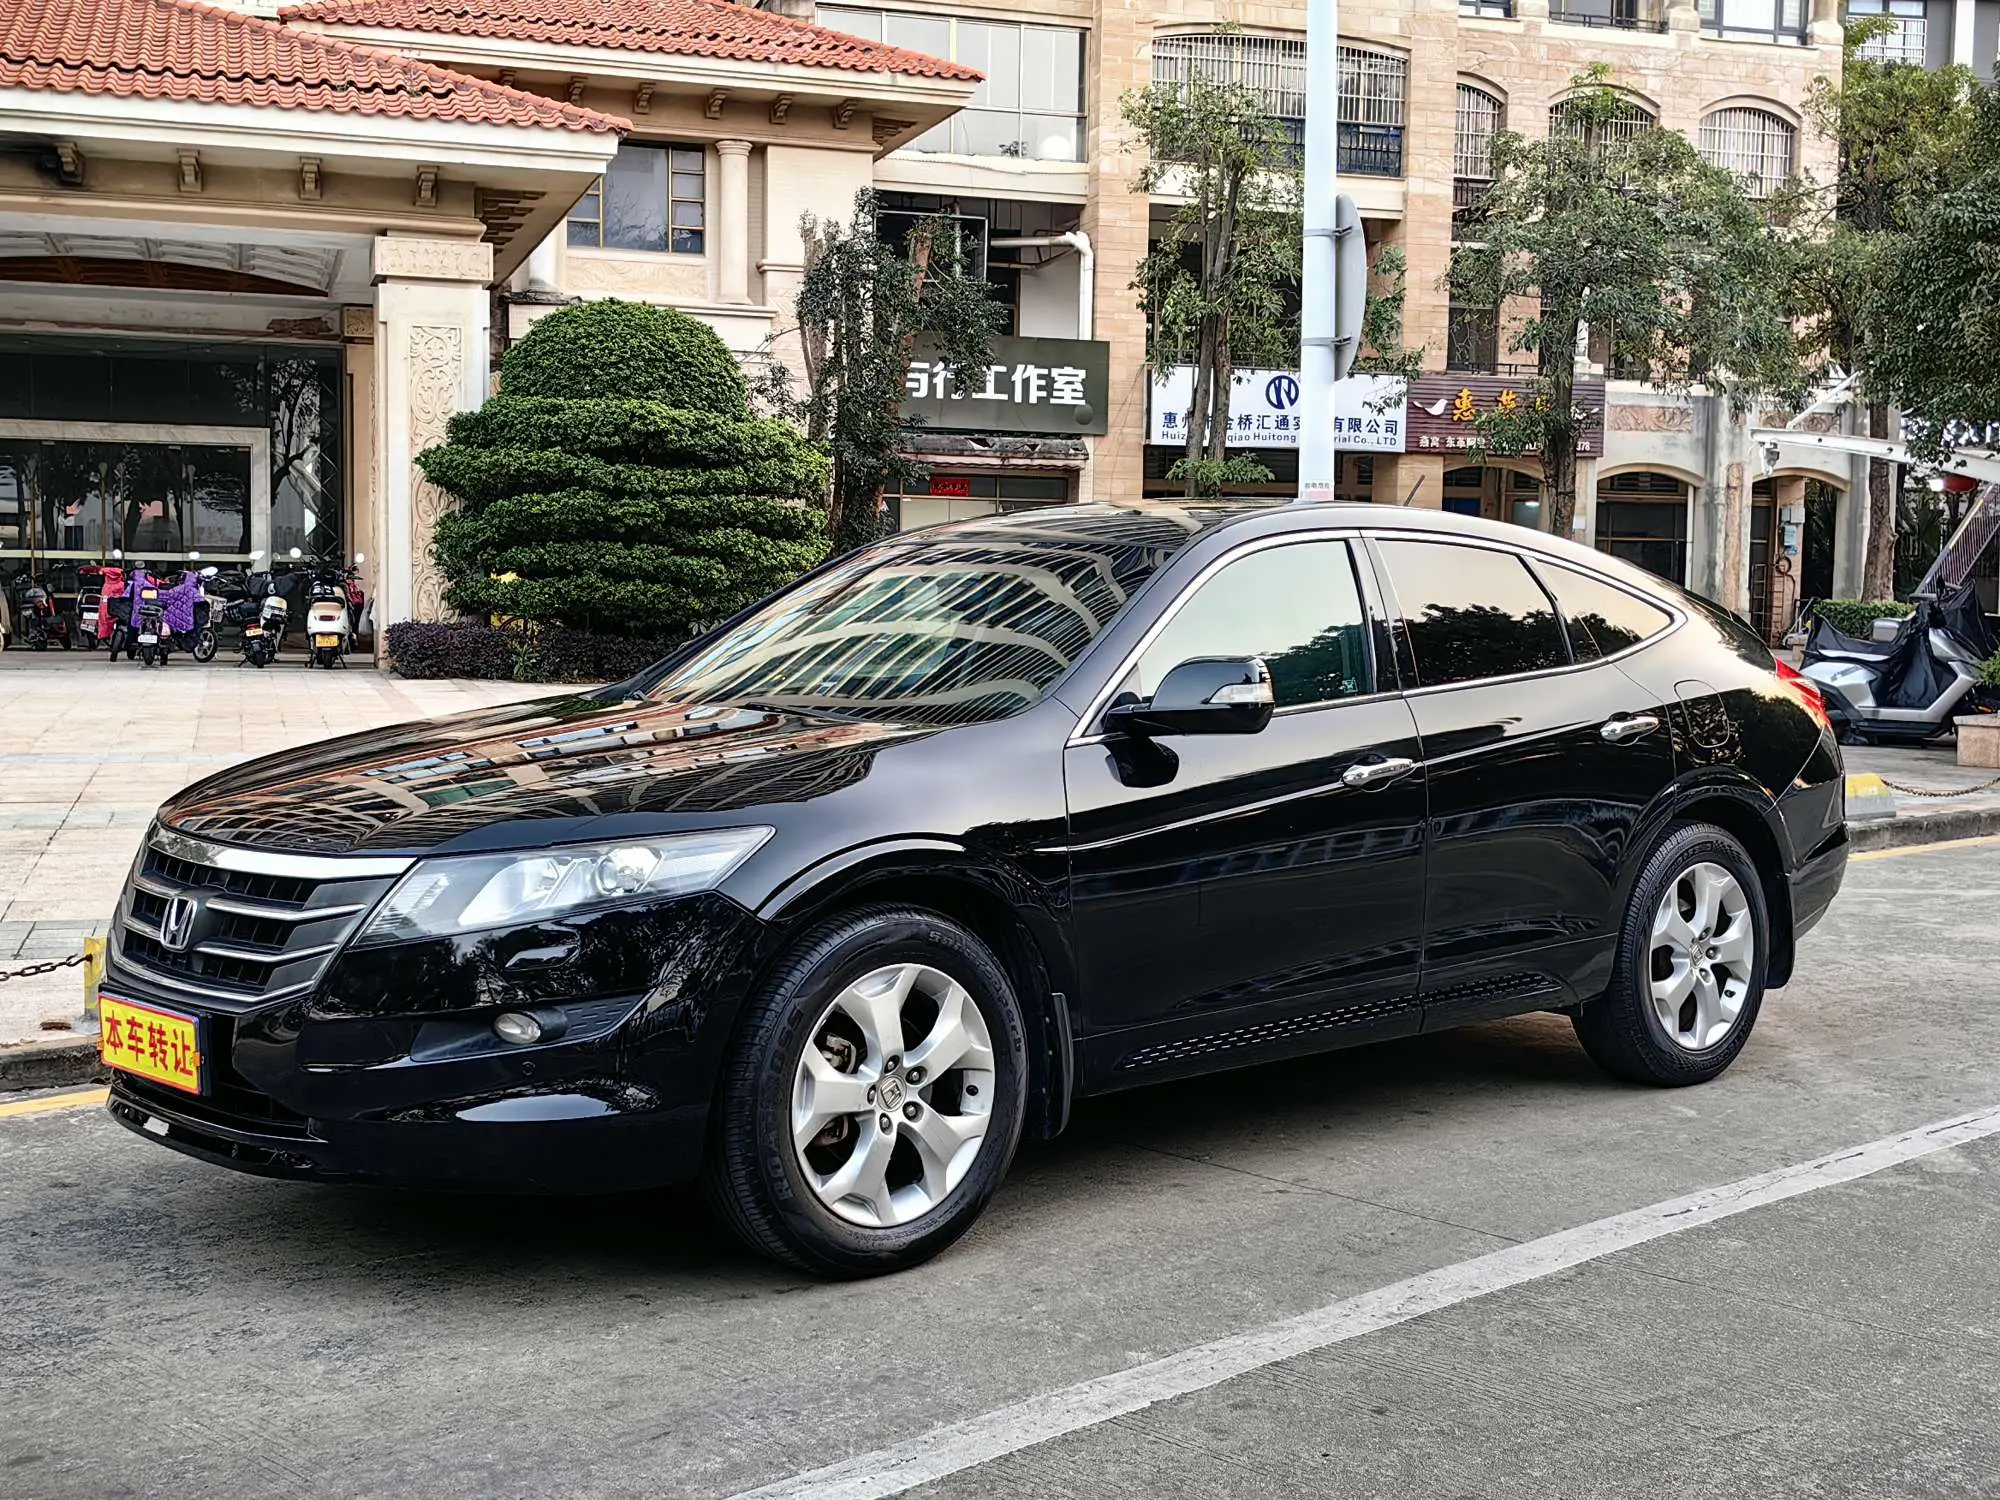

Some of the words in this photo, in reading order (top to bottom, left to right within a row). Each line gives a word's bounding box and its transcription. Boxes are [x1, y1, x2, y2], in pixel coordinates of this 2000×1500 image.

[1162, 411, 1398, 436] 惠桥汇通有限公司
[1253, 432, 1297, 443] Huitong
[105, 1009, 193, 1077] 本车转让
